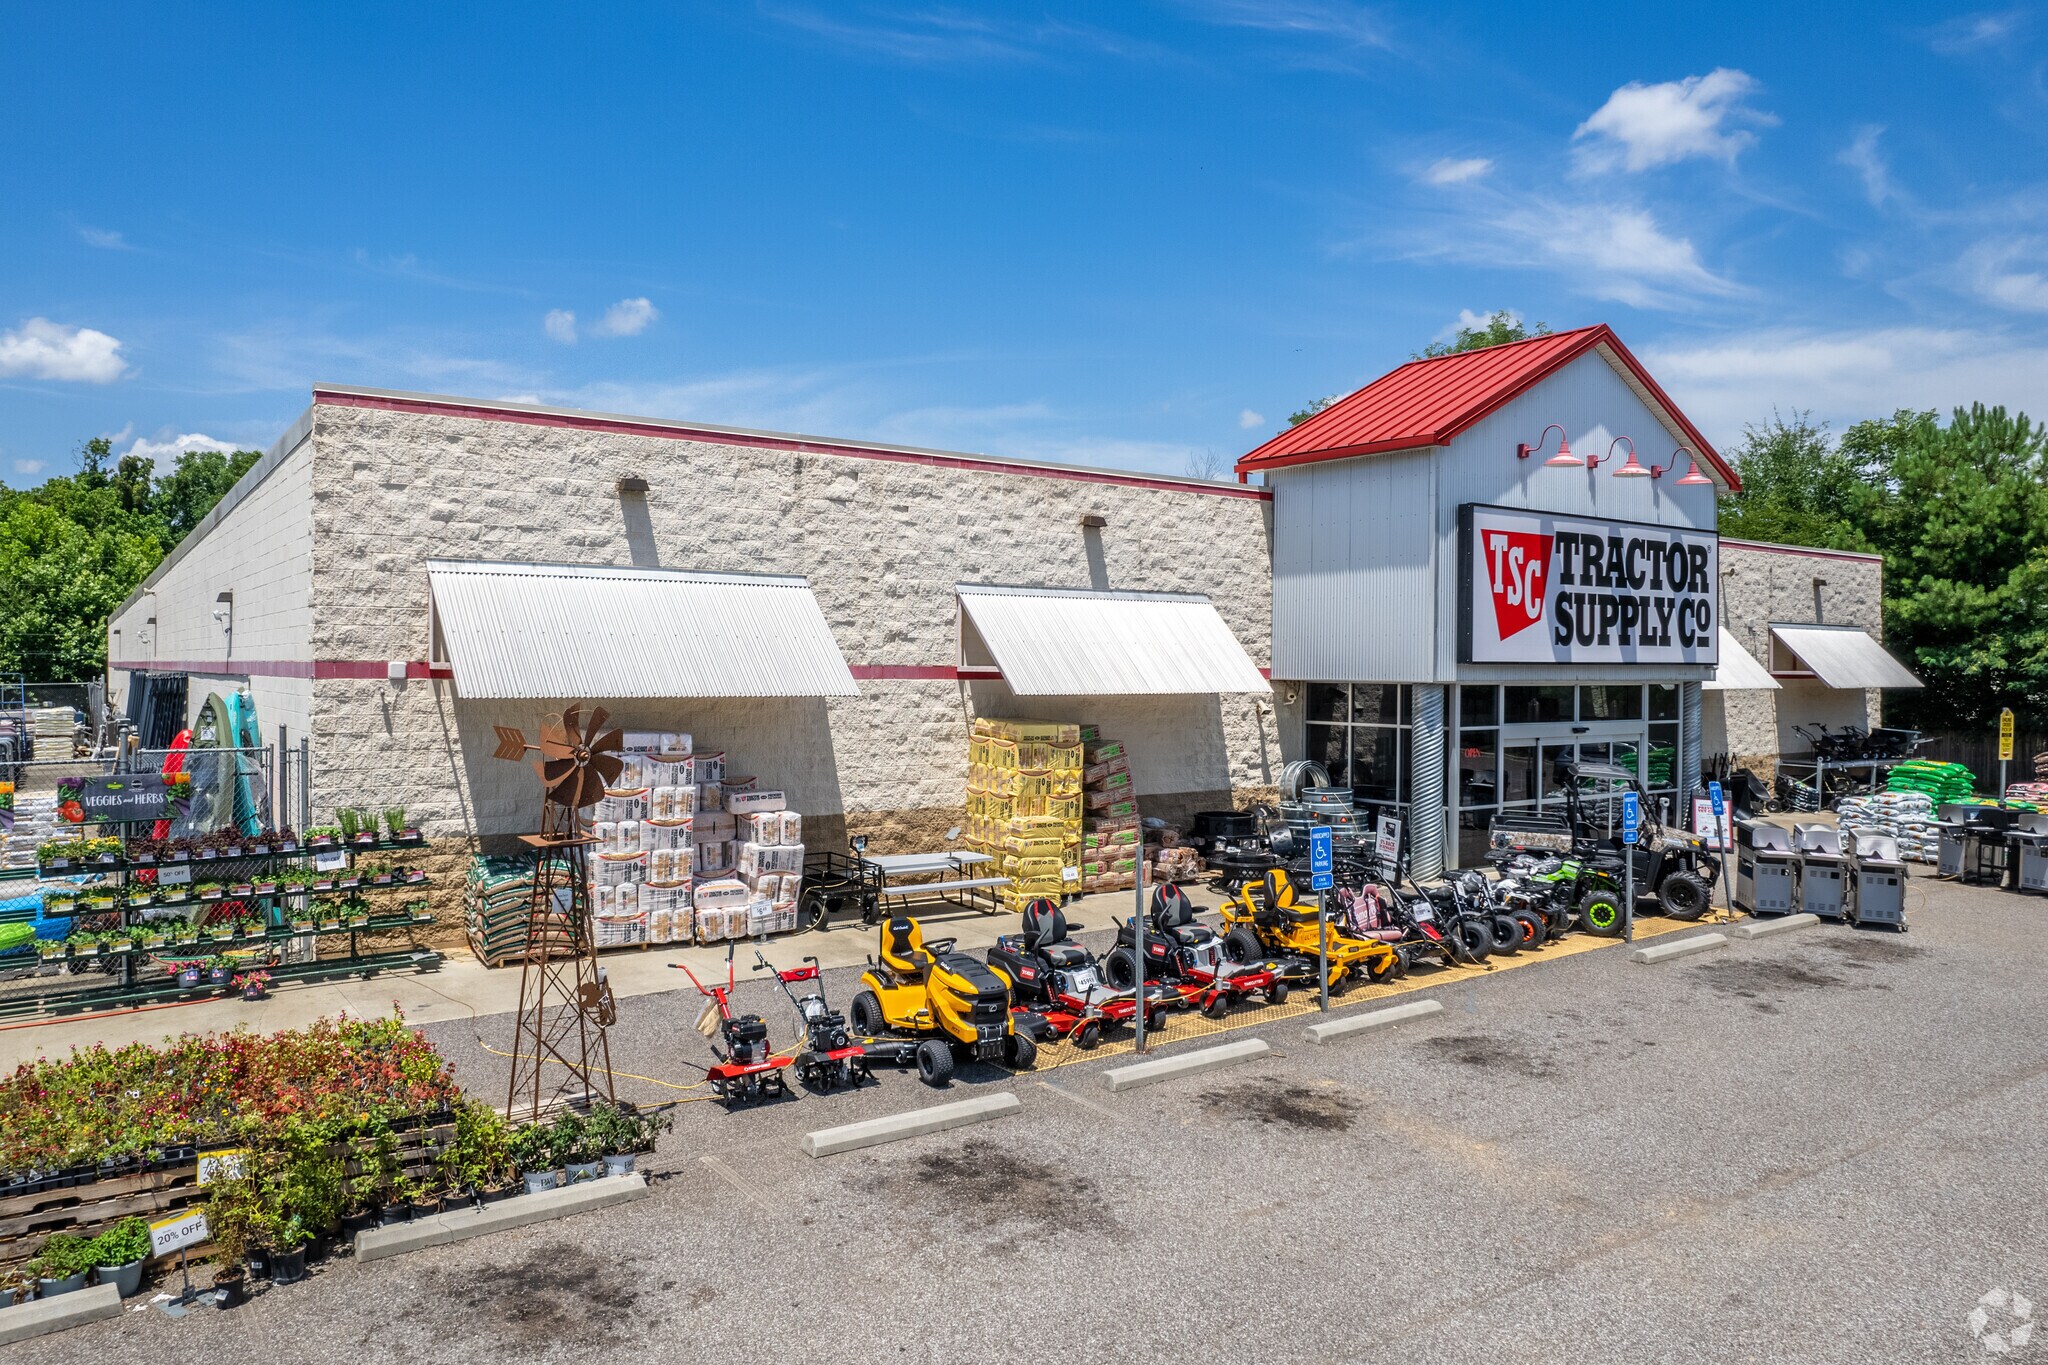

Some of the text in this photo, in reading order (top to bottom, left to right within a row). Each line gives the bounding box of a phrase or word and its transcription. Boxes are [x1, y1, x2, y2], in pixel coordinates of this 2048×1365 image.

[1555, 530, 1710, 594] TRACTOR
[1490, 533, 1541, 620] TSC
[1554, 591, 1676, 647] SUPPLY
[85, 794, 122, 807] VEGGIES
[134, 792, 164, 805] HERBS
[1153, 945, 1165, 953] TORO
[1021, 968, 1035, 977] TORO
[157, 1221, 203, 1246] 20% OFF
